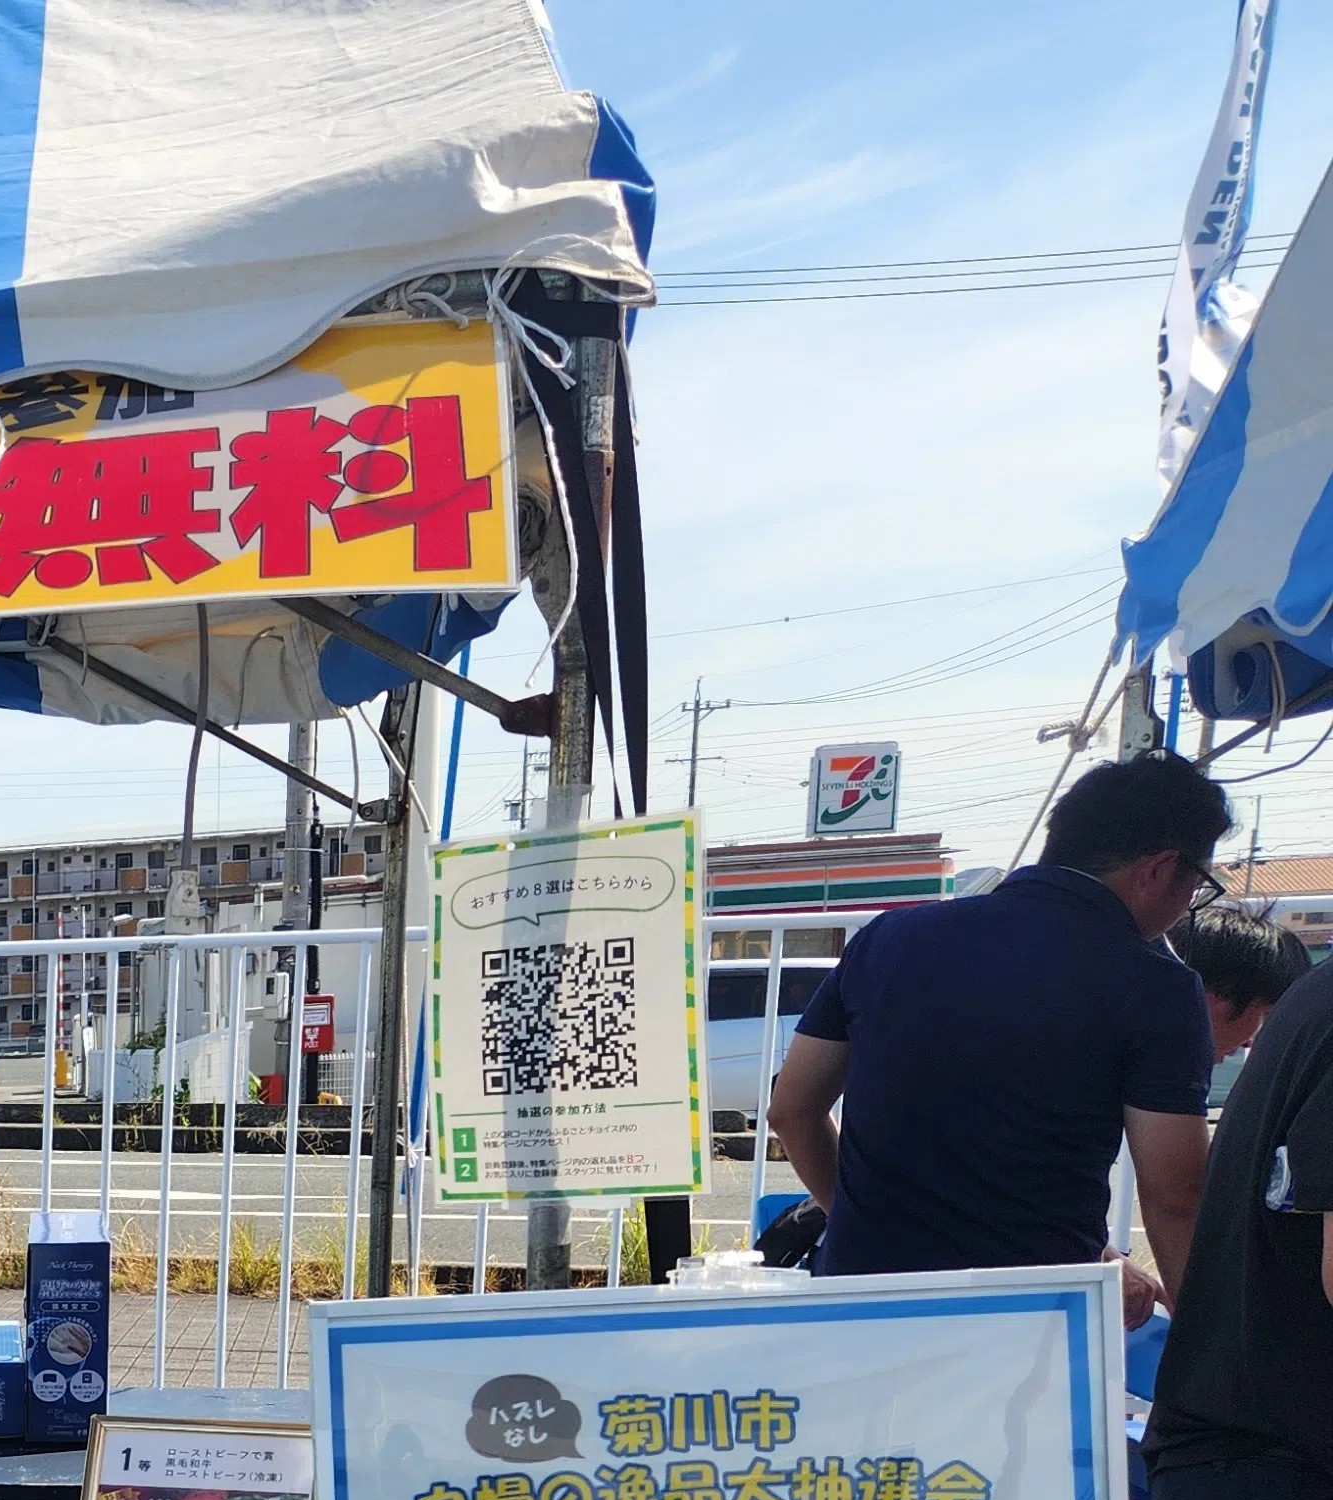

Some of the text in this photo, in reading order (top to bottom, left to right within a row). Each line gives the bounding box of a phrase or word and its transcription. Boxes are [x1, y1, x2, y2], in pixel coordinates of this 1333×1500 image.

[470, 875, 653, 910] おすすめ8選はこちらから
[516, 1102, 607, 1119] 抽選の参加方法
[489, 1398, 557, 1425] ハズレ
[600, 1390, 801, 1457] 菊川市
[502, 1423, 548, 1448] なし
[164, 1457, 213, 1469] 黒毛和牛
[167, 1448, 275, 1461] ローストビーフで賞
